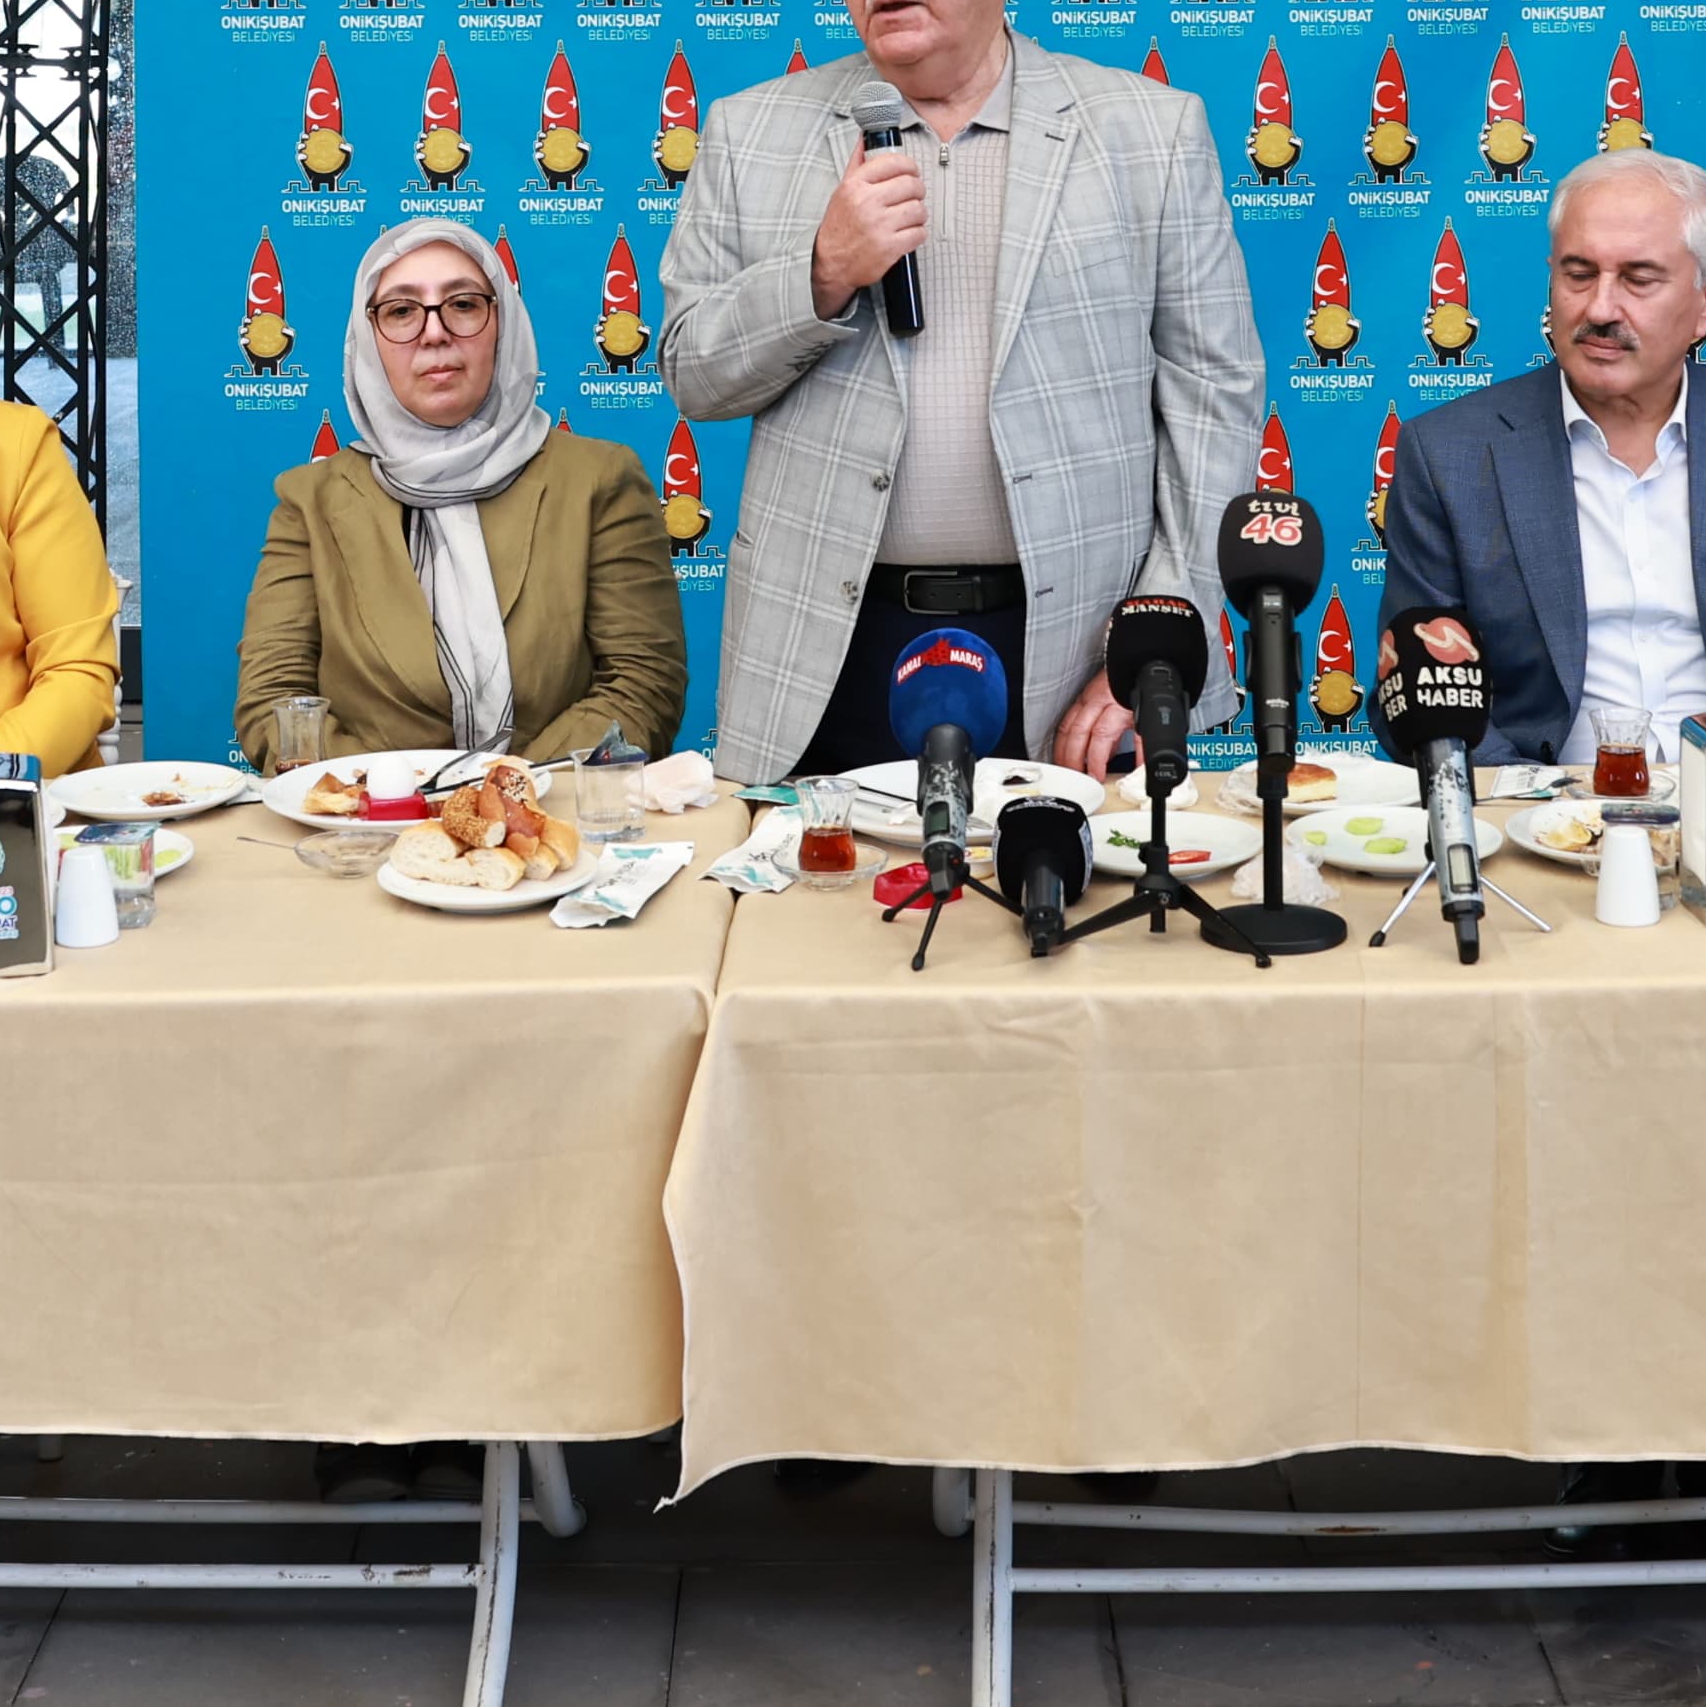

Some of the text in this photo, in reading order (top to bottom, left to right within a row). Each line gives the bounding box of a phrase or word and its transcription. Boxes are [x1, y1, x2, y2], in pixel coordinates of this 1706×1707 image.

[1240, 512, 1303, 546] 46
[1417, 666, 1483, 687] AKSU
[1416, 688, 1485, 709] HABER
